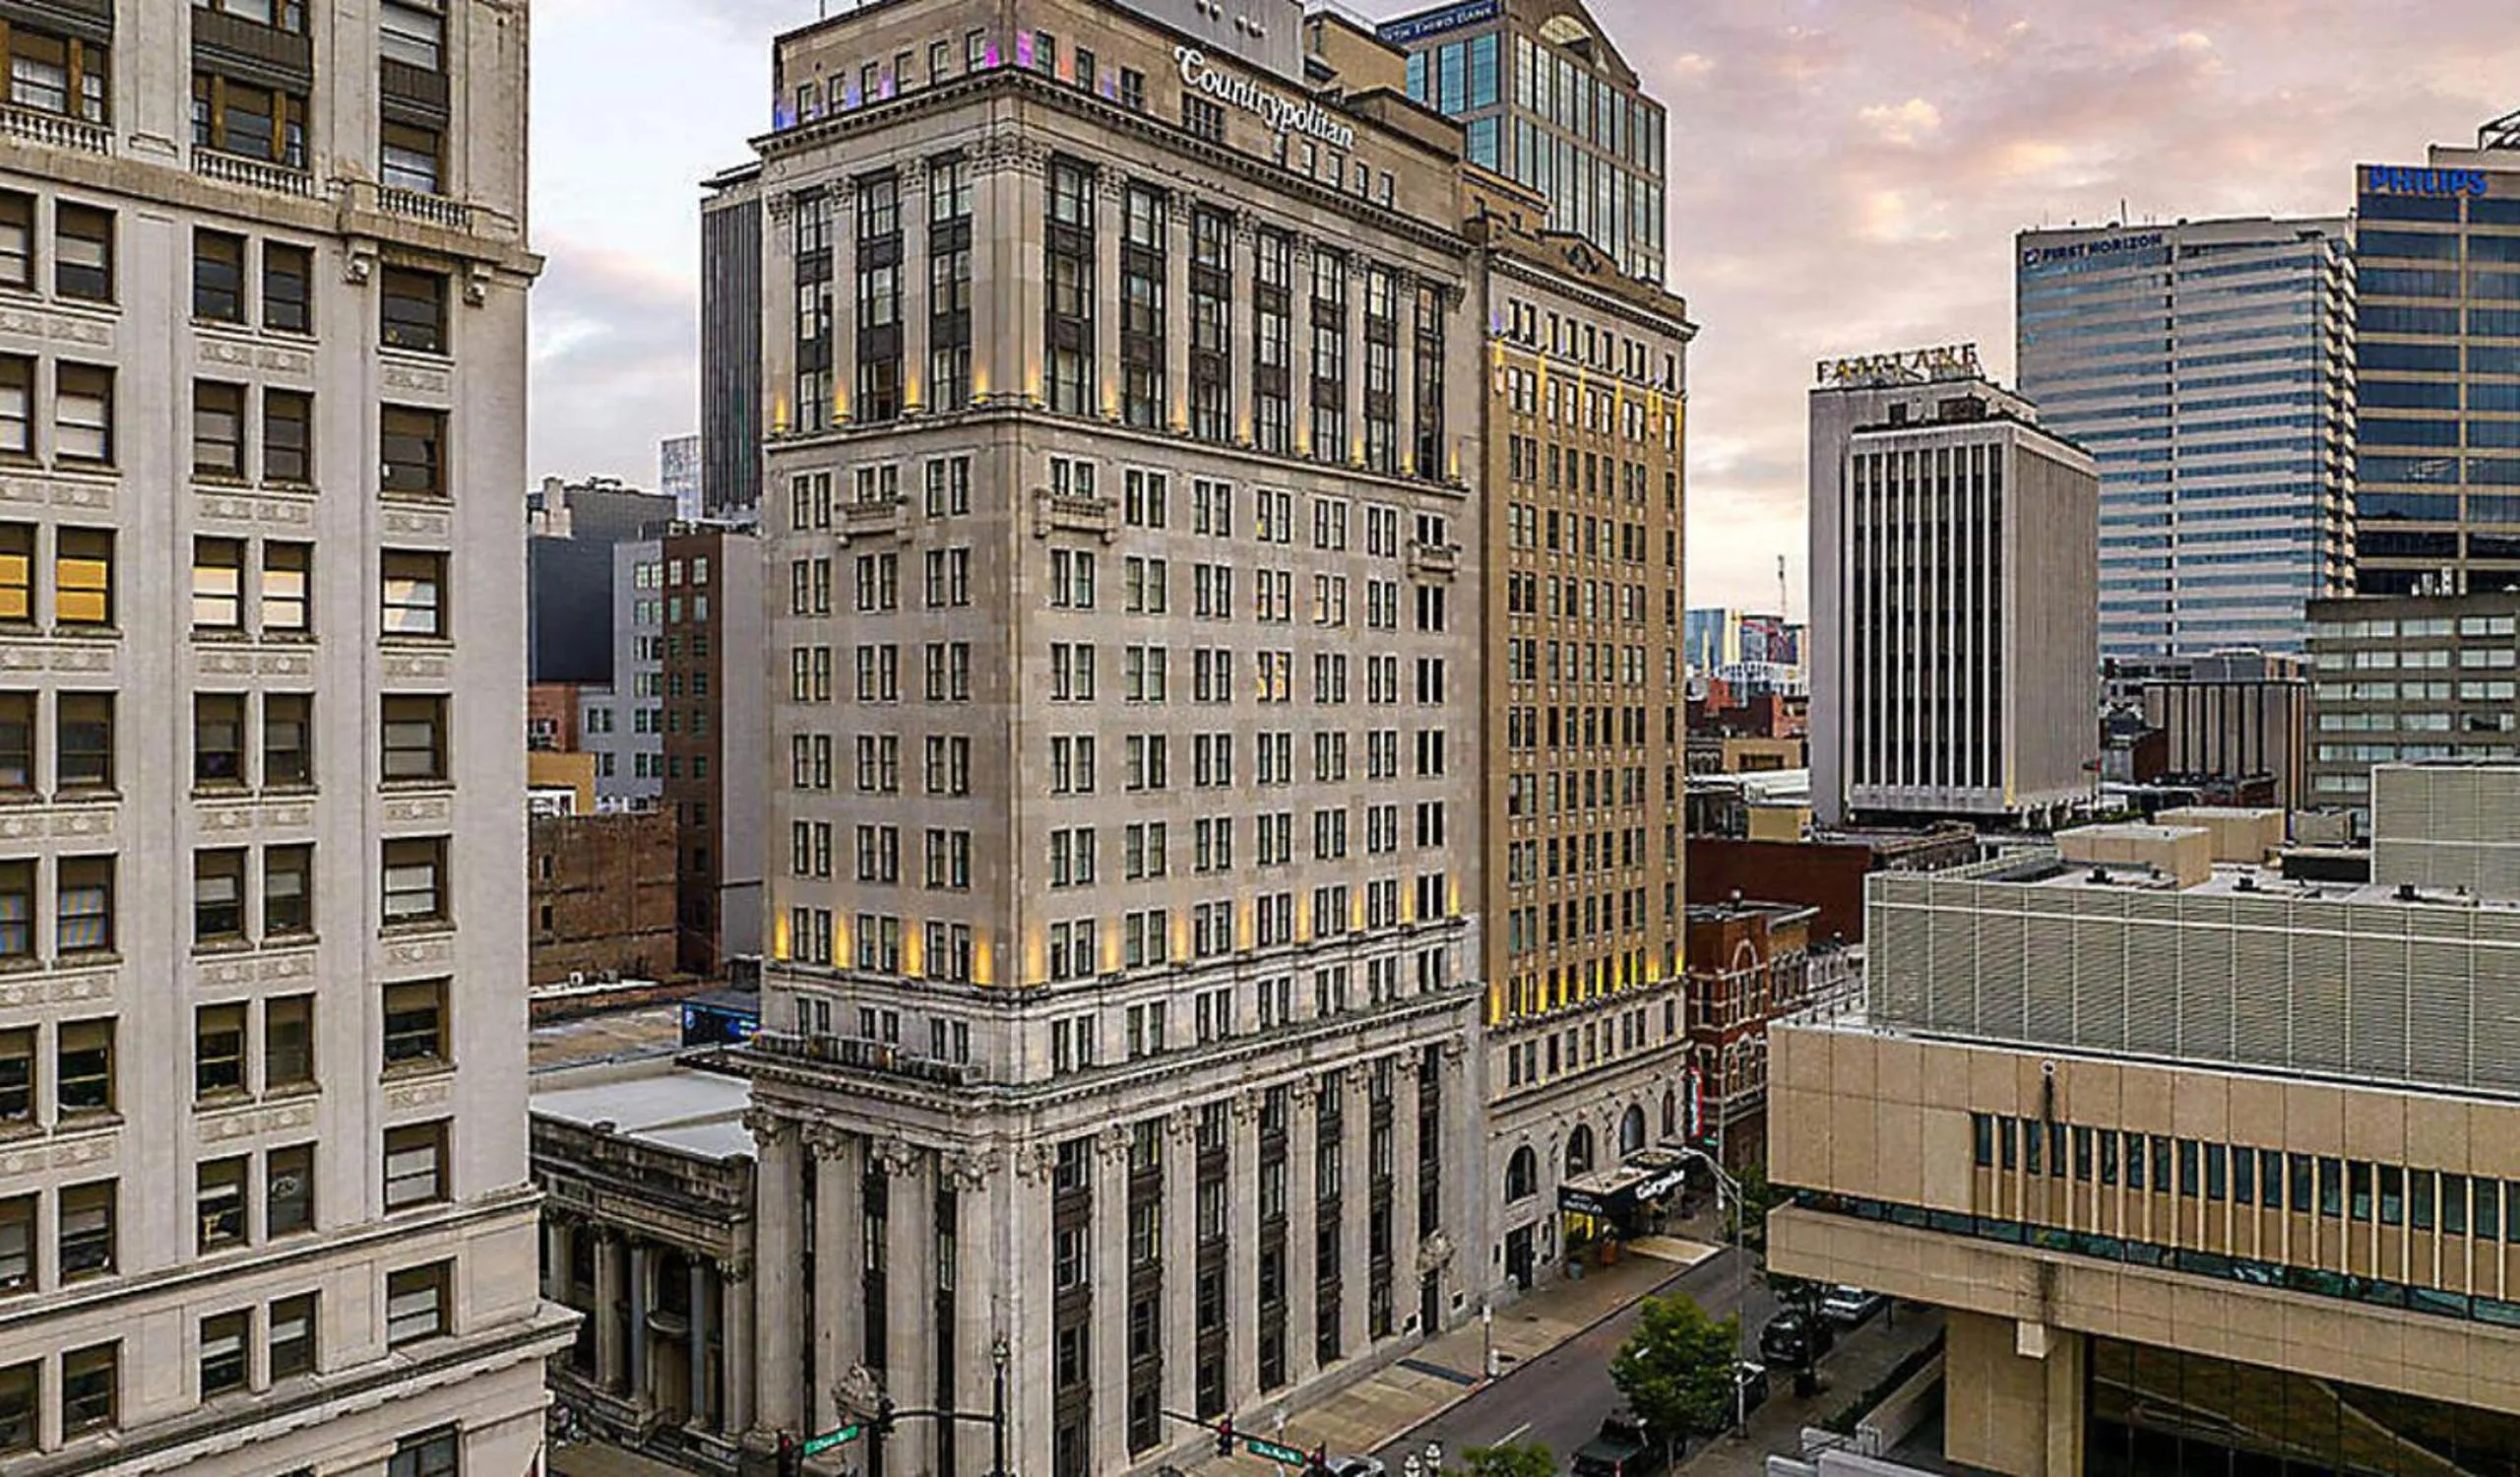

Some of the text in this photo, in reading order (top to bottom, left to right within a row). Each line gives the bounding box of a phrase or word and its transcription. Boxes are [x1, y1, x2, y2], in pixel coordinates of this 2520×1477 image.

[1174, 46, 1354, 150] Countrypolitan
[2369, 165, 2488, 195] PHILIPS
[2089, 234, 2163, 255] HORIZON
